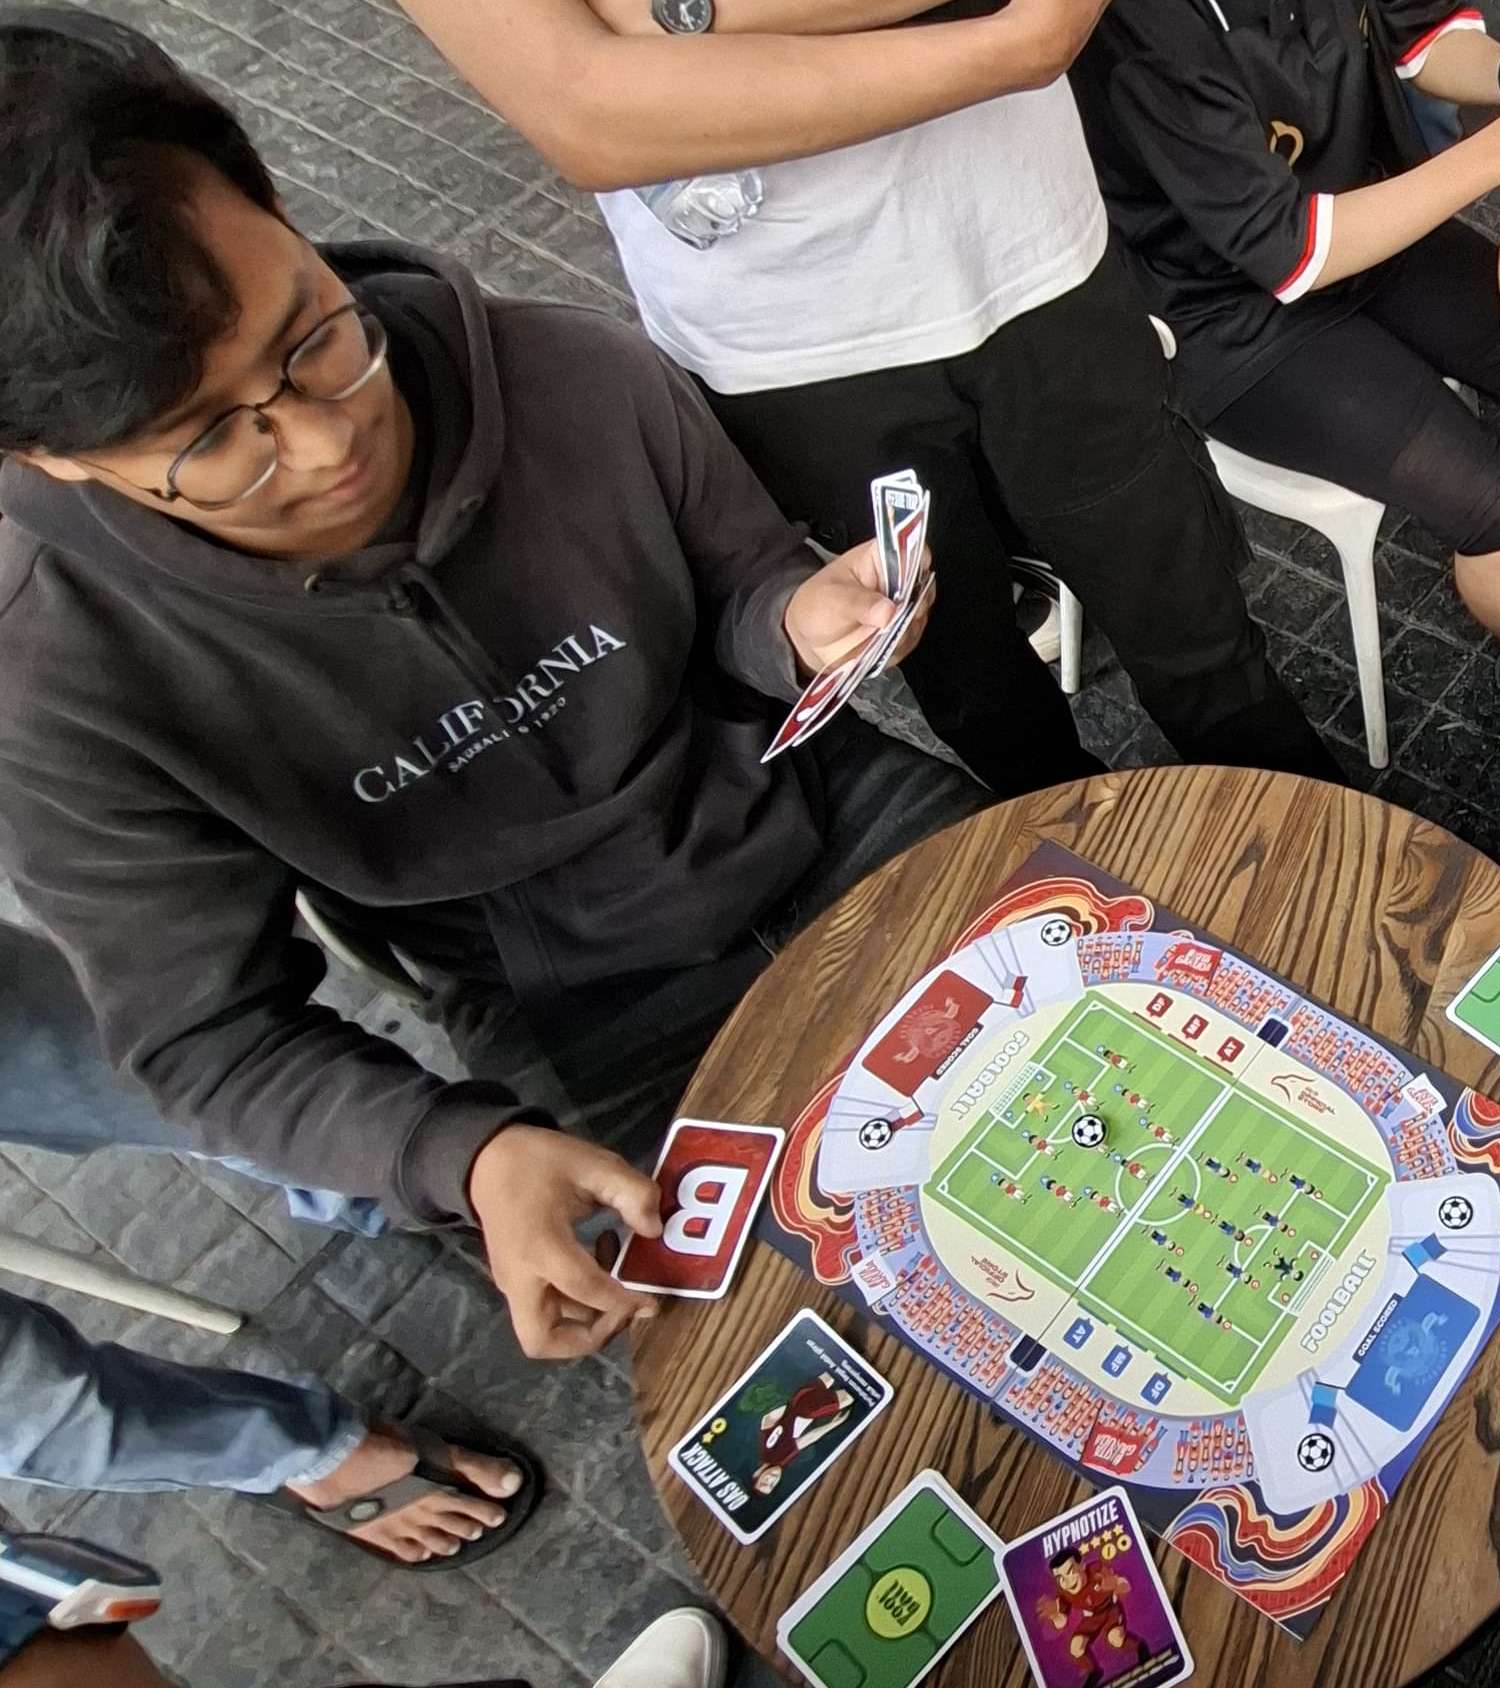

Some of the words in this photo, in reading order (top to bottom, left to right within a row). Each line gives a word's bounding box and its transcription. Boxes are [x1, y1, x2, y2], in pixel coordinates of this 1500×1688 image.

[353, 624, 627, 803] CALIFORNIA
[951, 1030, 1030, 1120] FOOLBALL
[662, 1165, 750, 1257] B
[1300, 1252, 1377, 1354] FOOLBALL
[1357, 1333, 1377, 1357] GOAL
[1372, 1299, 1399, 1334] SCORED
[1069, 1324, 1087, 1344] AT
[1151, 1380, 1166, 1400] DF
[680, 1443, 732, 1492] ATTACK
[1043, 1499, 1120, 1559] HYPNOTIZE
[878, 1591, 912, 1626] FOOL
[889, 1579, 921, 1614] BALL
